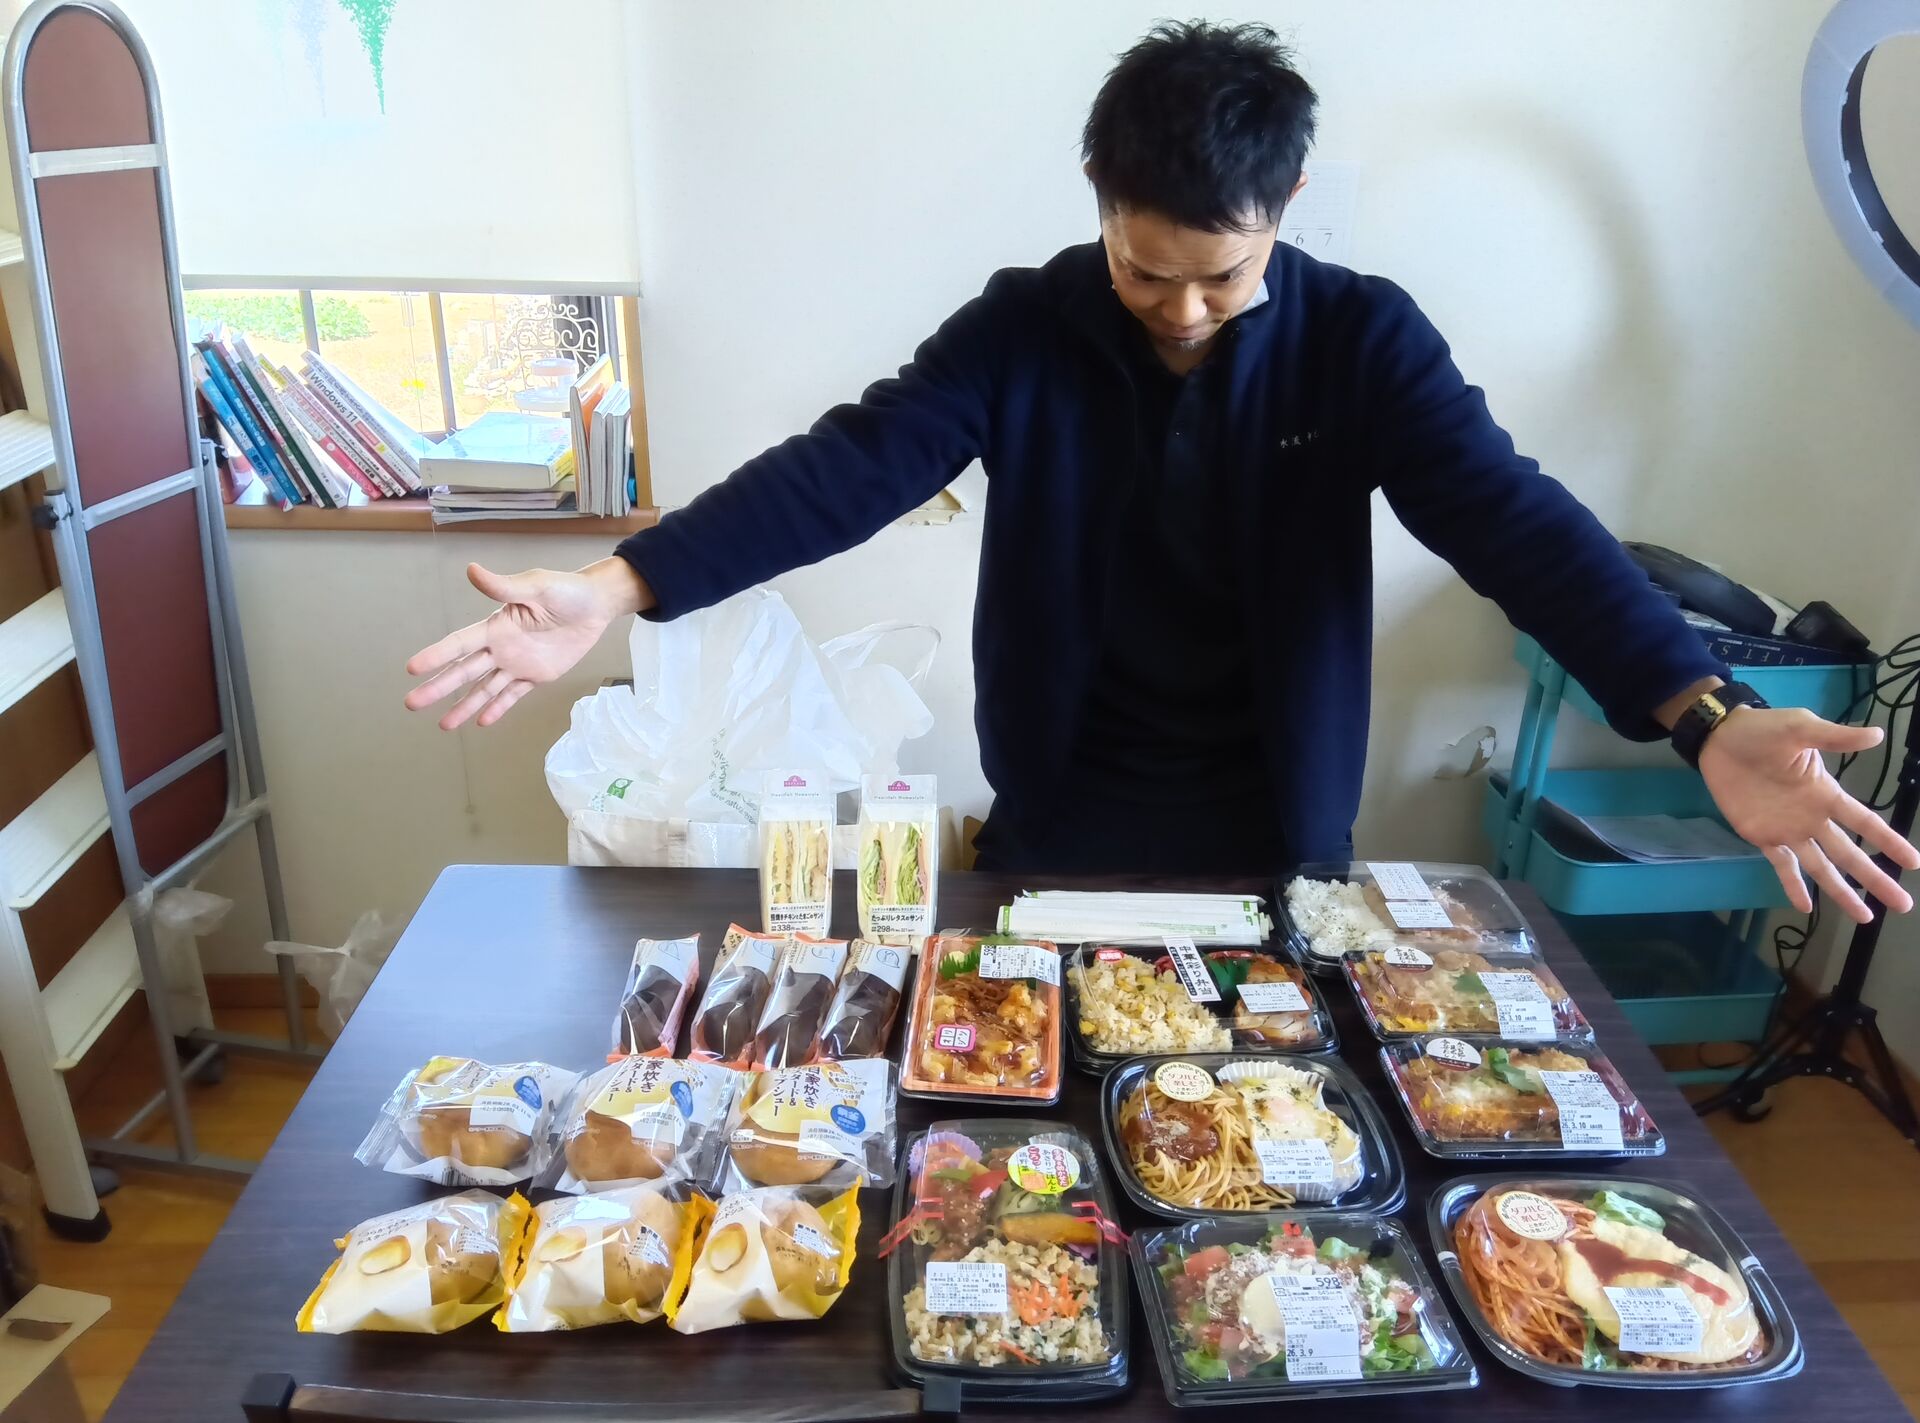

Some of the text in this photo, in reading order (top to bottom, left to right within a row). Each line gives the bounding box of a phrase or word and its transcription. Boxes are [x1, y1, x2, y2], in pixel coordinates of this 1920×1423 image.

[1295, 232, 1333, 246] 6 7
[311, 372, 358, 423] Windows 11
[871, 914, 925, 922] たっぷりレタスのサンド
[1178, 945, 1213, 995] 中華彩り弁当
[1578, 1073, 1599, 1082] 598
[1315, 1277, 1341, 1287] 598
[1287, 1348, 1314, 1357] 26.3.9
